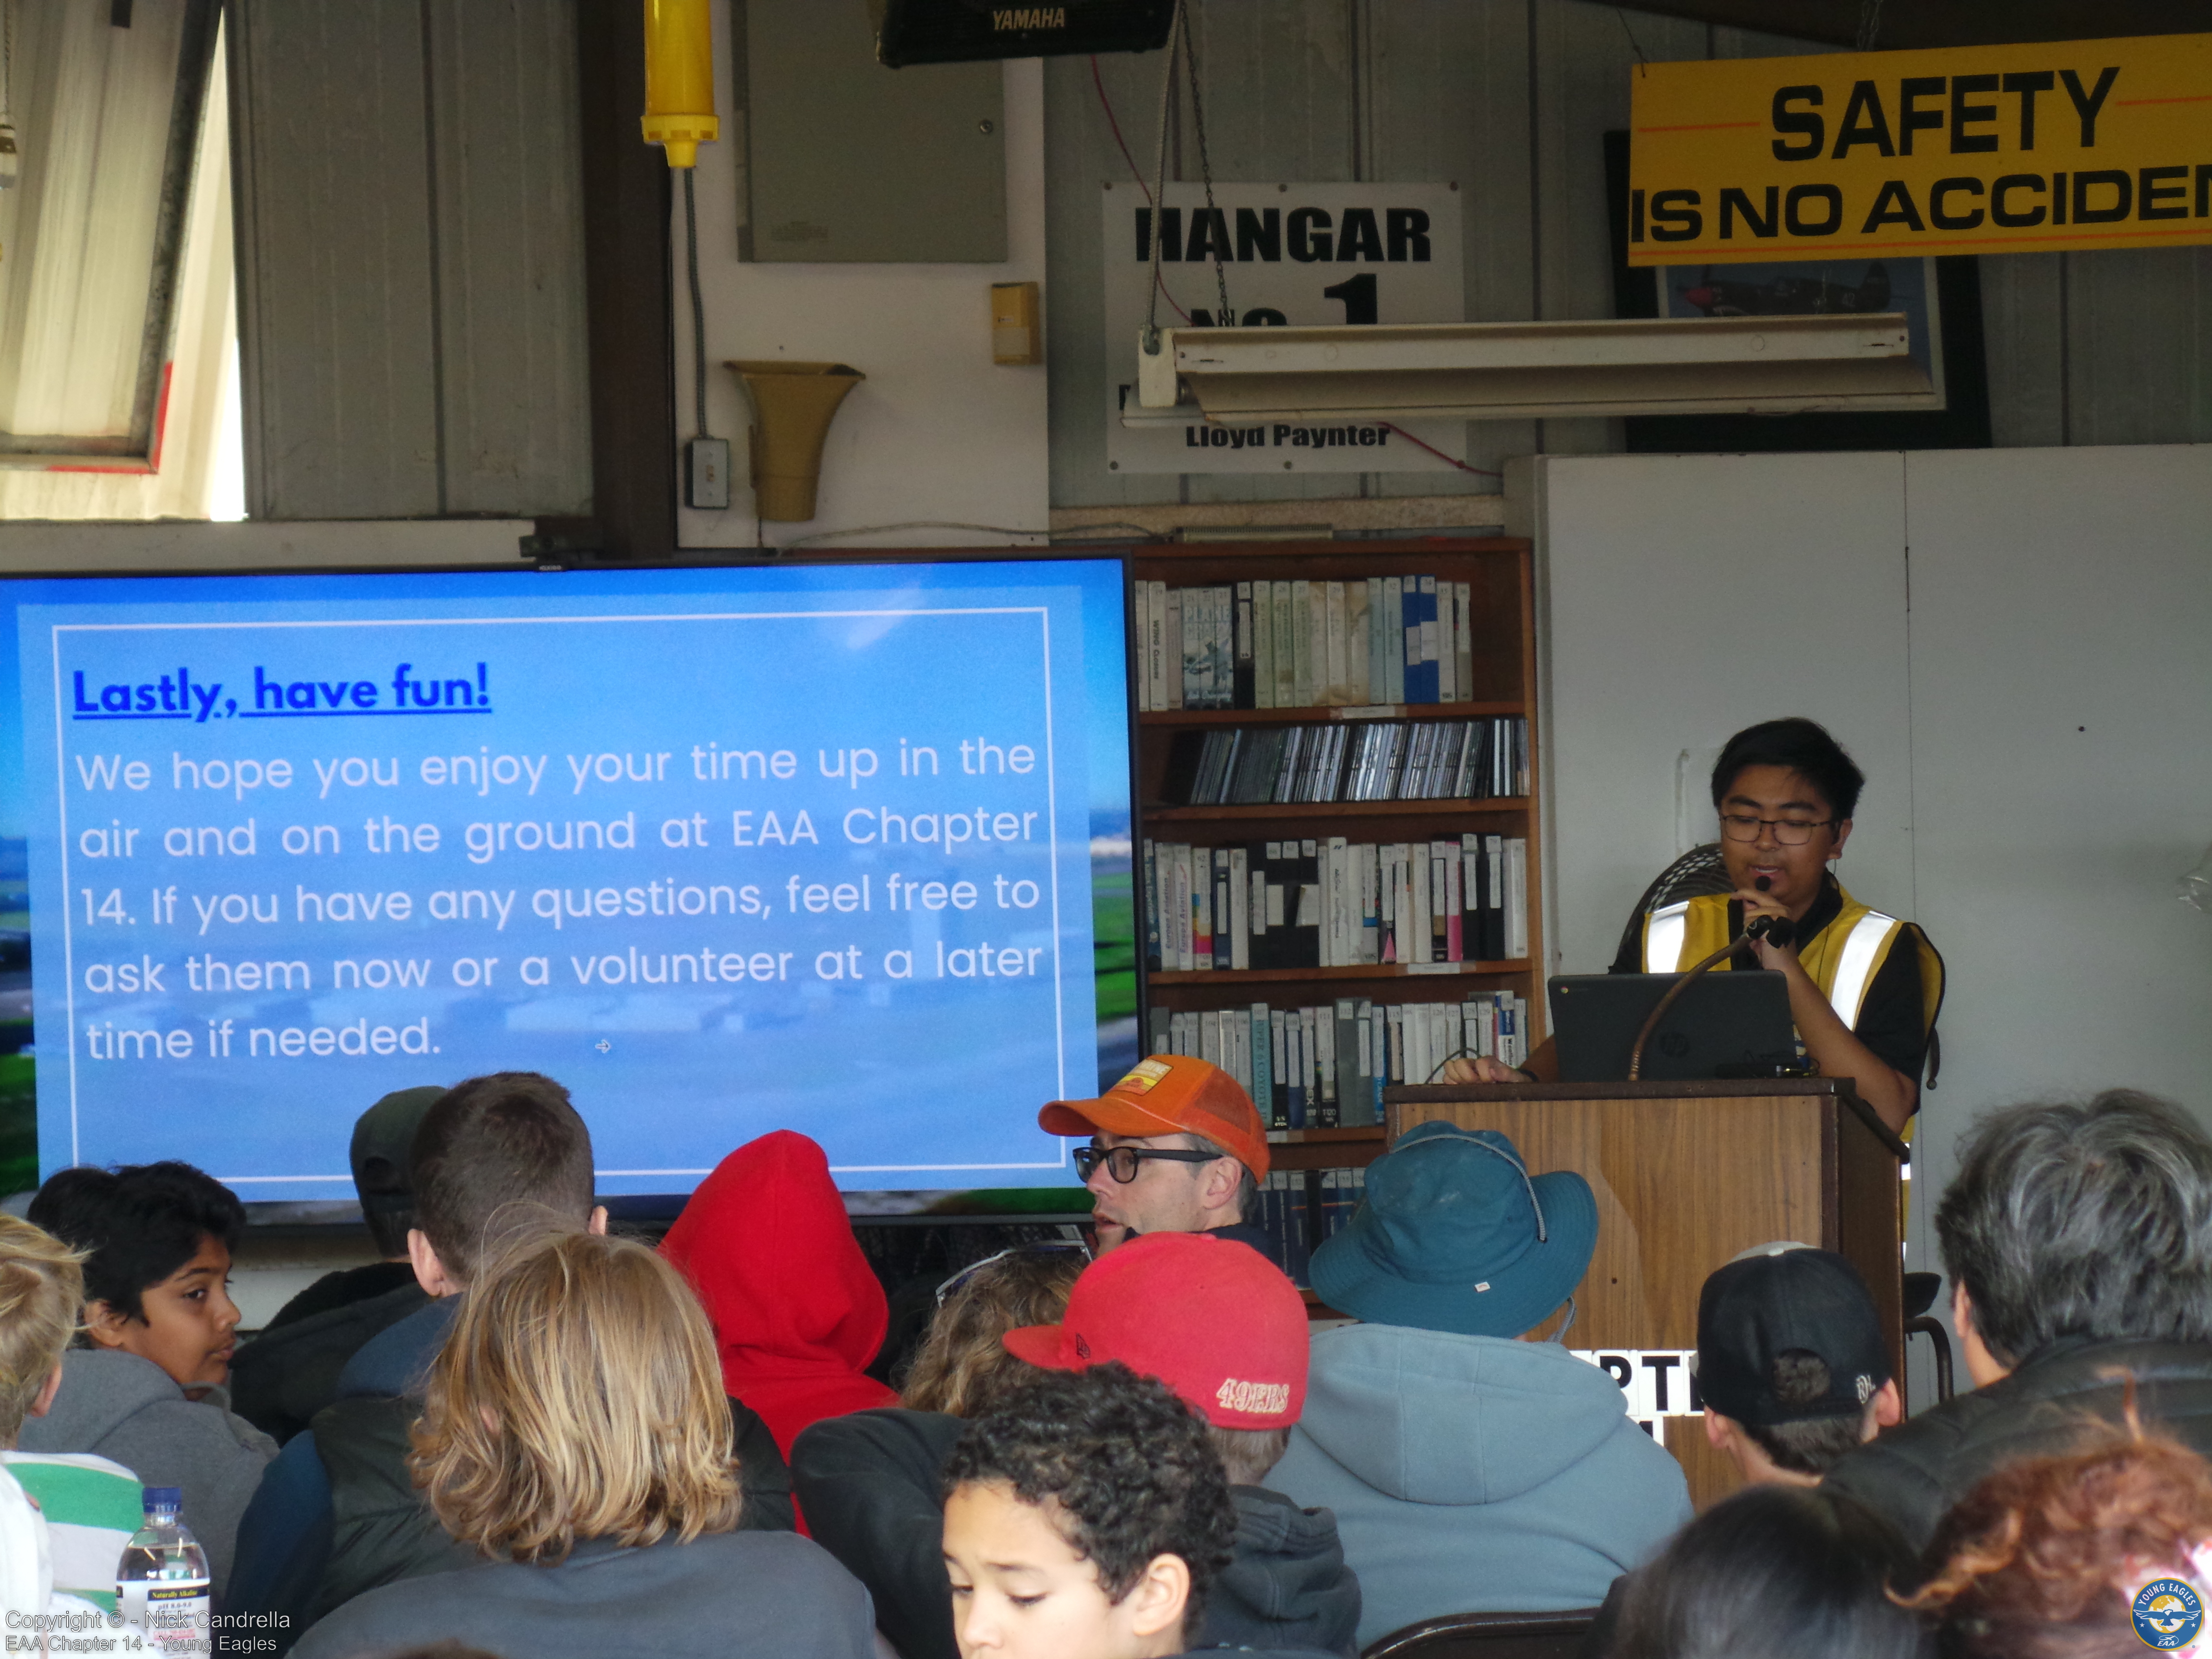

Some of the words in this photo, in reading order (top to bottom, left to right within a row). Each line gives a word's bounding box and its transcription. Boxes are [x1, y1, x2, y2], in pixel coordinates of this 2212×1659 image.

[993, 8, 1066, 30] YAMAHA
[1771, 66, 2120, 161] SAFETY
[1135, 207, 1431, 262] HANGAR
[1631, 188, 1703, 243] IS
[1719, 183, 1843, 240] NO
[1187, 425, 1265, 449] Lloyd
[1274, 424, 1390, 448] Paynter
[73, 667, 237, 722] Lastly,
[254, 667, 378, 712] have
[390, 662, 491, 710] fun!
[75, 754, 151, 792] We
[173, 751, 294, 801] hope
[313, 756, 399, 800] you
[420, 745, 548, 797] enjoy
[567, 752, 672, 795] your
[690, 741, 797, 781] time
[819, 747, 879, 790] up
[900, 737, 938, 776] in
[959, 736, 1035, 775] the
[80, 818, 139, 858] air
[164, 817, 256, 857] and
[282, 824, 340, 855] on
[364, 816, 440, 853] the
[465, 813, 636, 864] ground
[661, 811, 708, 849] at
[733, 809, 818, 847] EAA
[843, 805, 1038, 855] Chapter
[81, 888, 135, 926] 14.
[153, 886, 177, 925] If
[193, 893, 278, 936] you
[297, 885, 412, 922] have
[428, 890, 516, 931] any
[532, 877, 771, 930] questions,
[786, 874, 870, 914] feel
[887, 872, 978, 911] free
[994, 873, 1040, 909] to
[1145, 885, 1154, 924] Experience
[85, 954, 166, 994] ask
[186, 953, 311, 991] them
[334, 958, 431, 990] now
[453, 957, 498, 986] or
[520, 956, 549, 986] a
[571, 946, 793, 985] volunteer
[815, 944, 863, 981] at
[884, 949, 913, 979] a
[936, 939, 1042, 978] later
[87, 1021, 193, 1059] time
[209, 1018, 234, 1058] if
[250, 1016, 440, 1057] needed.
[1257, 1061, 1266, 1108] COYOTE
[1215, 1377, 1290, 1414] 49ERS
[152, 1591, 177, 1599] Naturally
